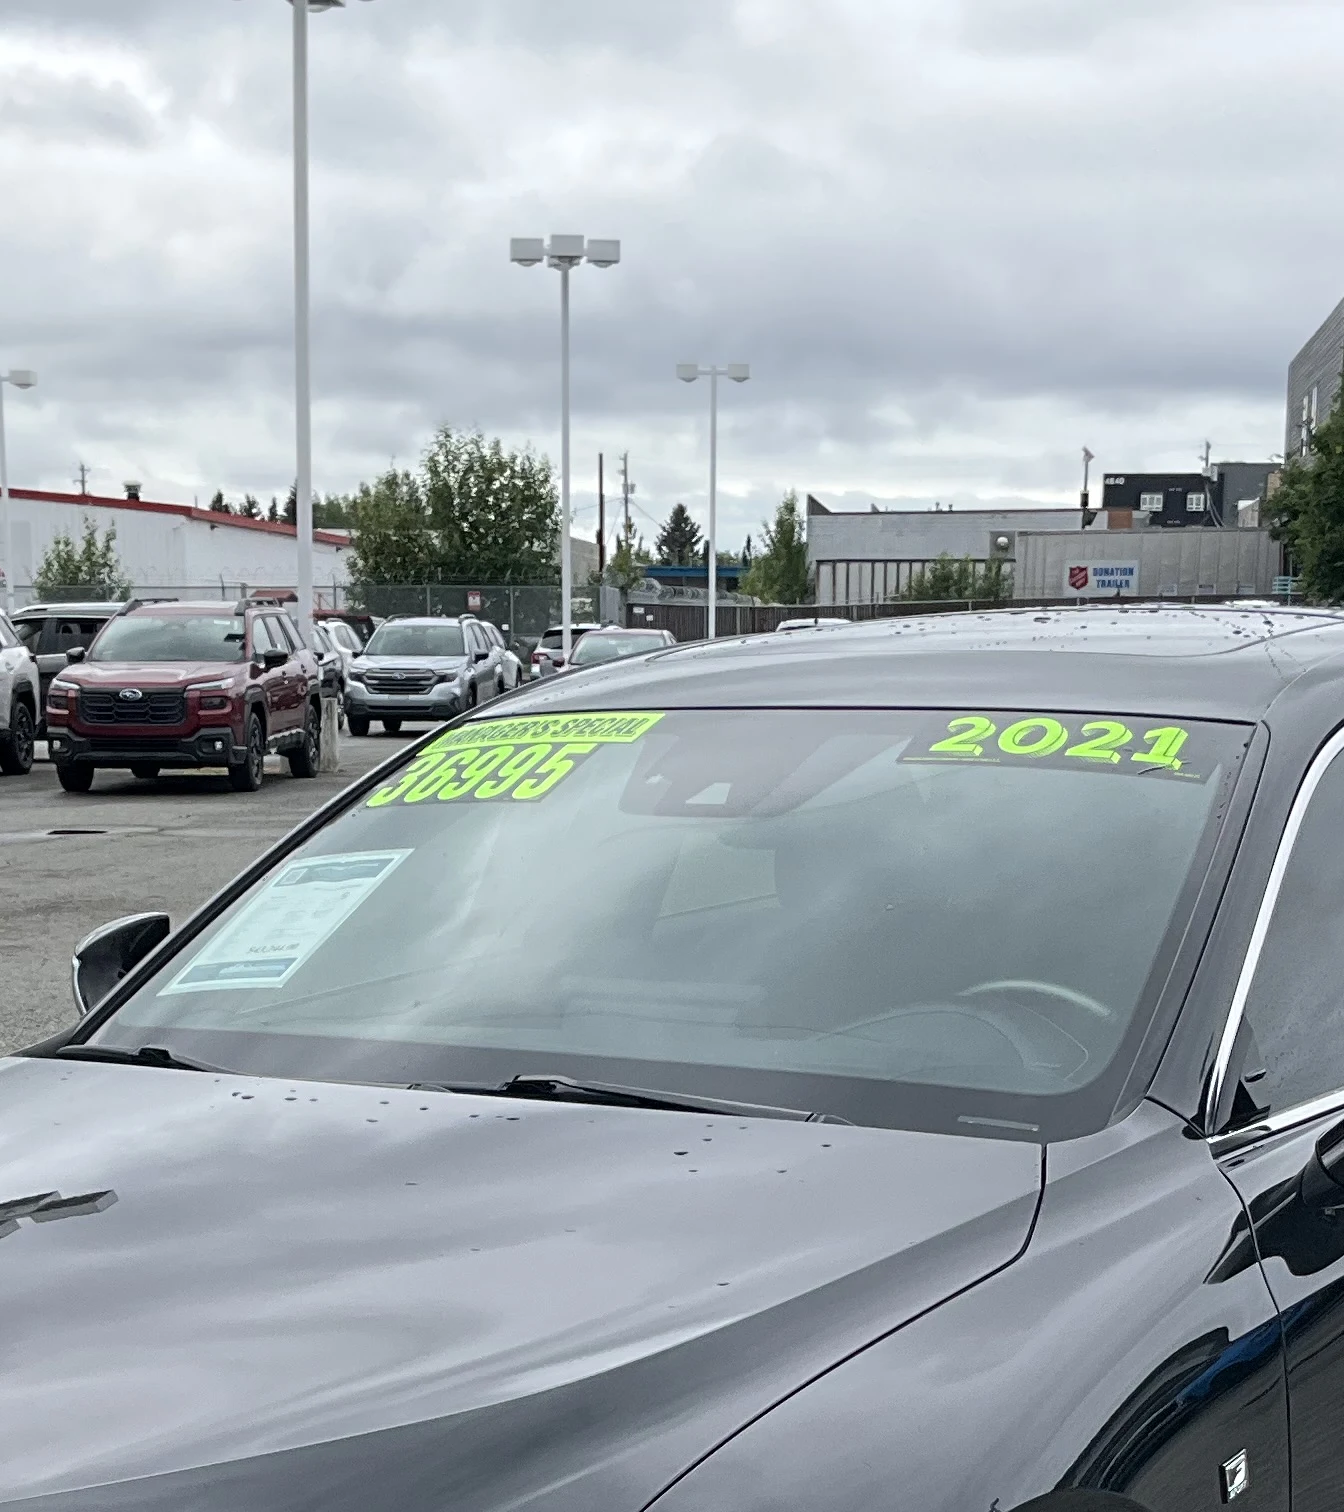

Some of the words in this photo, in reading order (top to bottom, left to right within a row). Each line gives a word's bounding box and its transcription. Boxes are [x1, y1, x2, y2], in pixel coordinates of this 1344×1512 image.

[1092, 567, 1135, 577] DONATION
[1096, 579, 1131, 589] TRAILER
[435, 718, 560, 749] MANAGER'S
[549, 716, 650, 738] SPECIAL
[928, 715, 1189, 771] 2021
[365, 743, 598, 808] 36995
